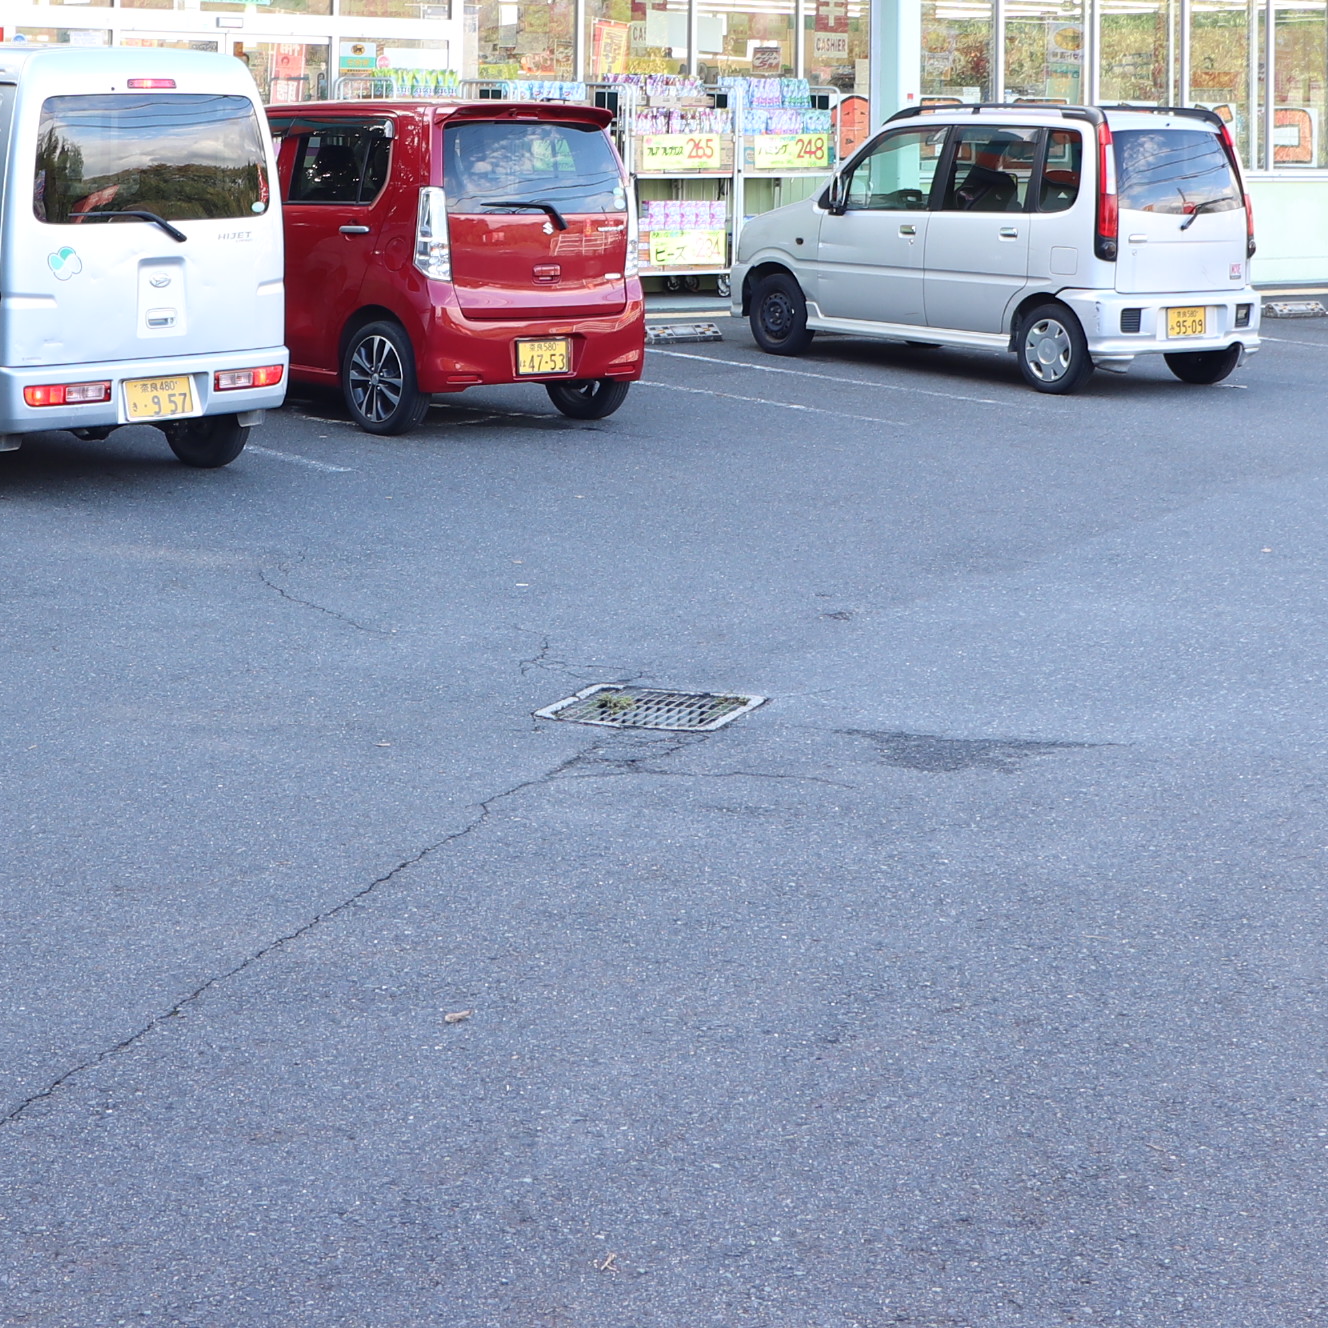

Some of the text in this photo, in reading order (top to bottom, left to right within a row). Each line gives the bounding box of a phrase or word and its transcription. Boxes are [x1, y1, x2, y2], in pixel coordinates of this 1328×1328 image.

[815, 38, 846, 52] CASHIER
[686, 137, 714, 159] 265
[795, 137, 825, 160] 248
[217, 231, 252, 241] HIJET
[139, 380, 176, 393] 奈良480
